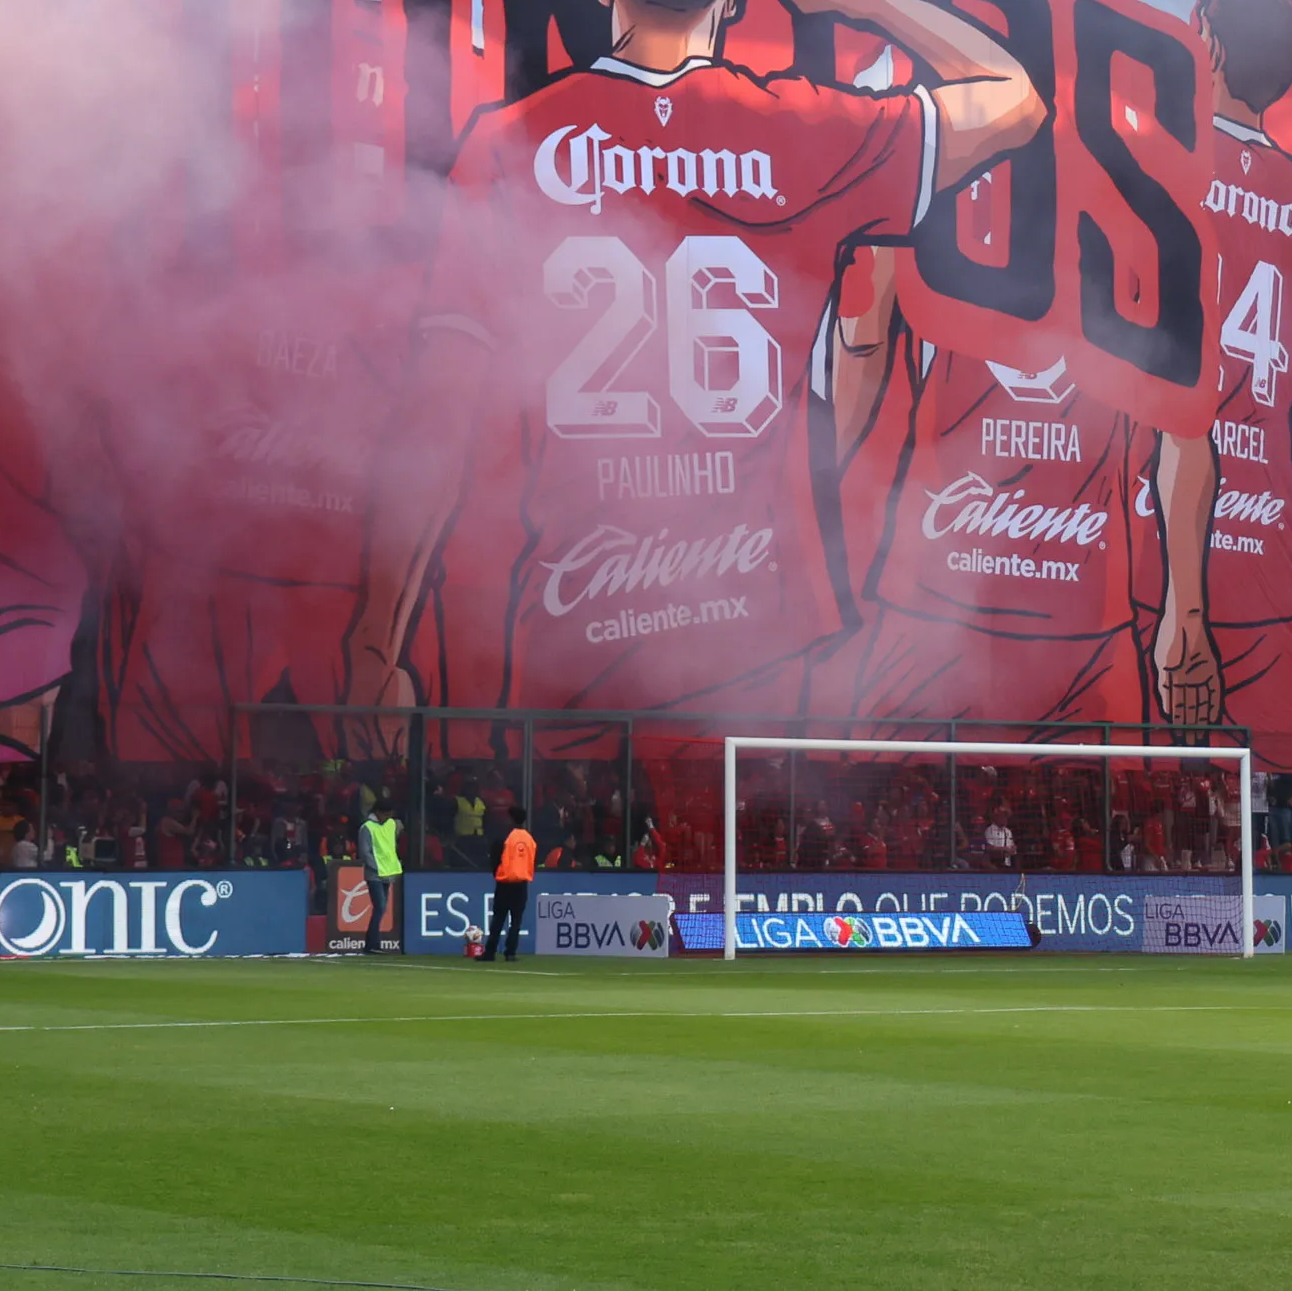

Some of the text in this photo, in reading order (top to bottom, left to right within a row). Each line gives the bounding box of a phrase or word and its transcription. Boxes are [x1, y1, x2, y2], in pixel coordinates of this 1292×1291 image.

[534, 123, 779, 215] Corona
[543, 236, 782, 439] 26
[1216, 253, 1289, 408] 4
[981, 418, 1082, 463] PEREIRA
[1211, 419, 1269, 464] ARCEL
[597, 451, 736, 501] PAULINHO
[923, 471, 1108, 547] Caliente
[539, 523, 774, 618] Caliente
[947, 549, 1079, 583] caliente.mx
[585, 595, 749, 645] caliente.mx
[421, 892, 471, 937] ES
[538, 901, 576, 920] LIGA
[733, 913, 980, 948] LIGA BBVA
[1145, 902, 1185, 920] LIGA
[556, 921, 626, 949] BBVA
[1165, 921, 1240, 947] BBVA
